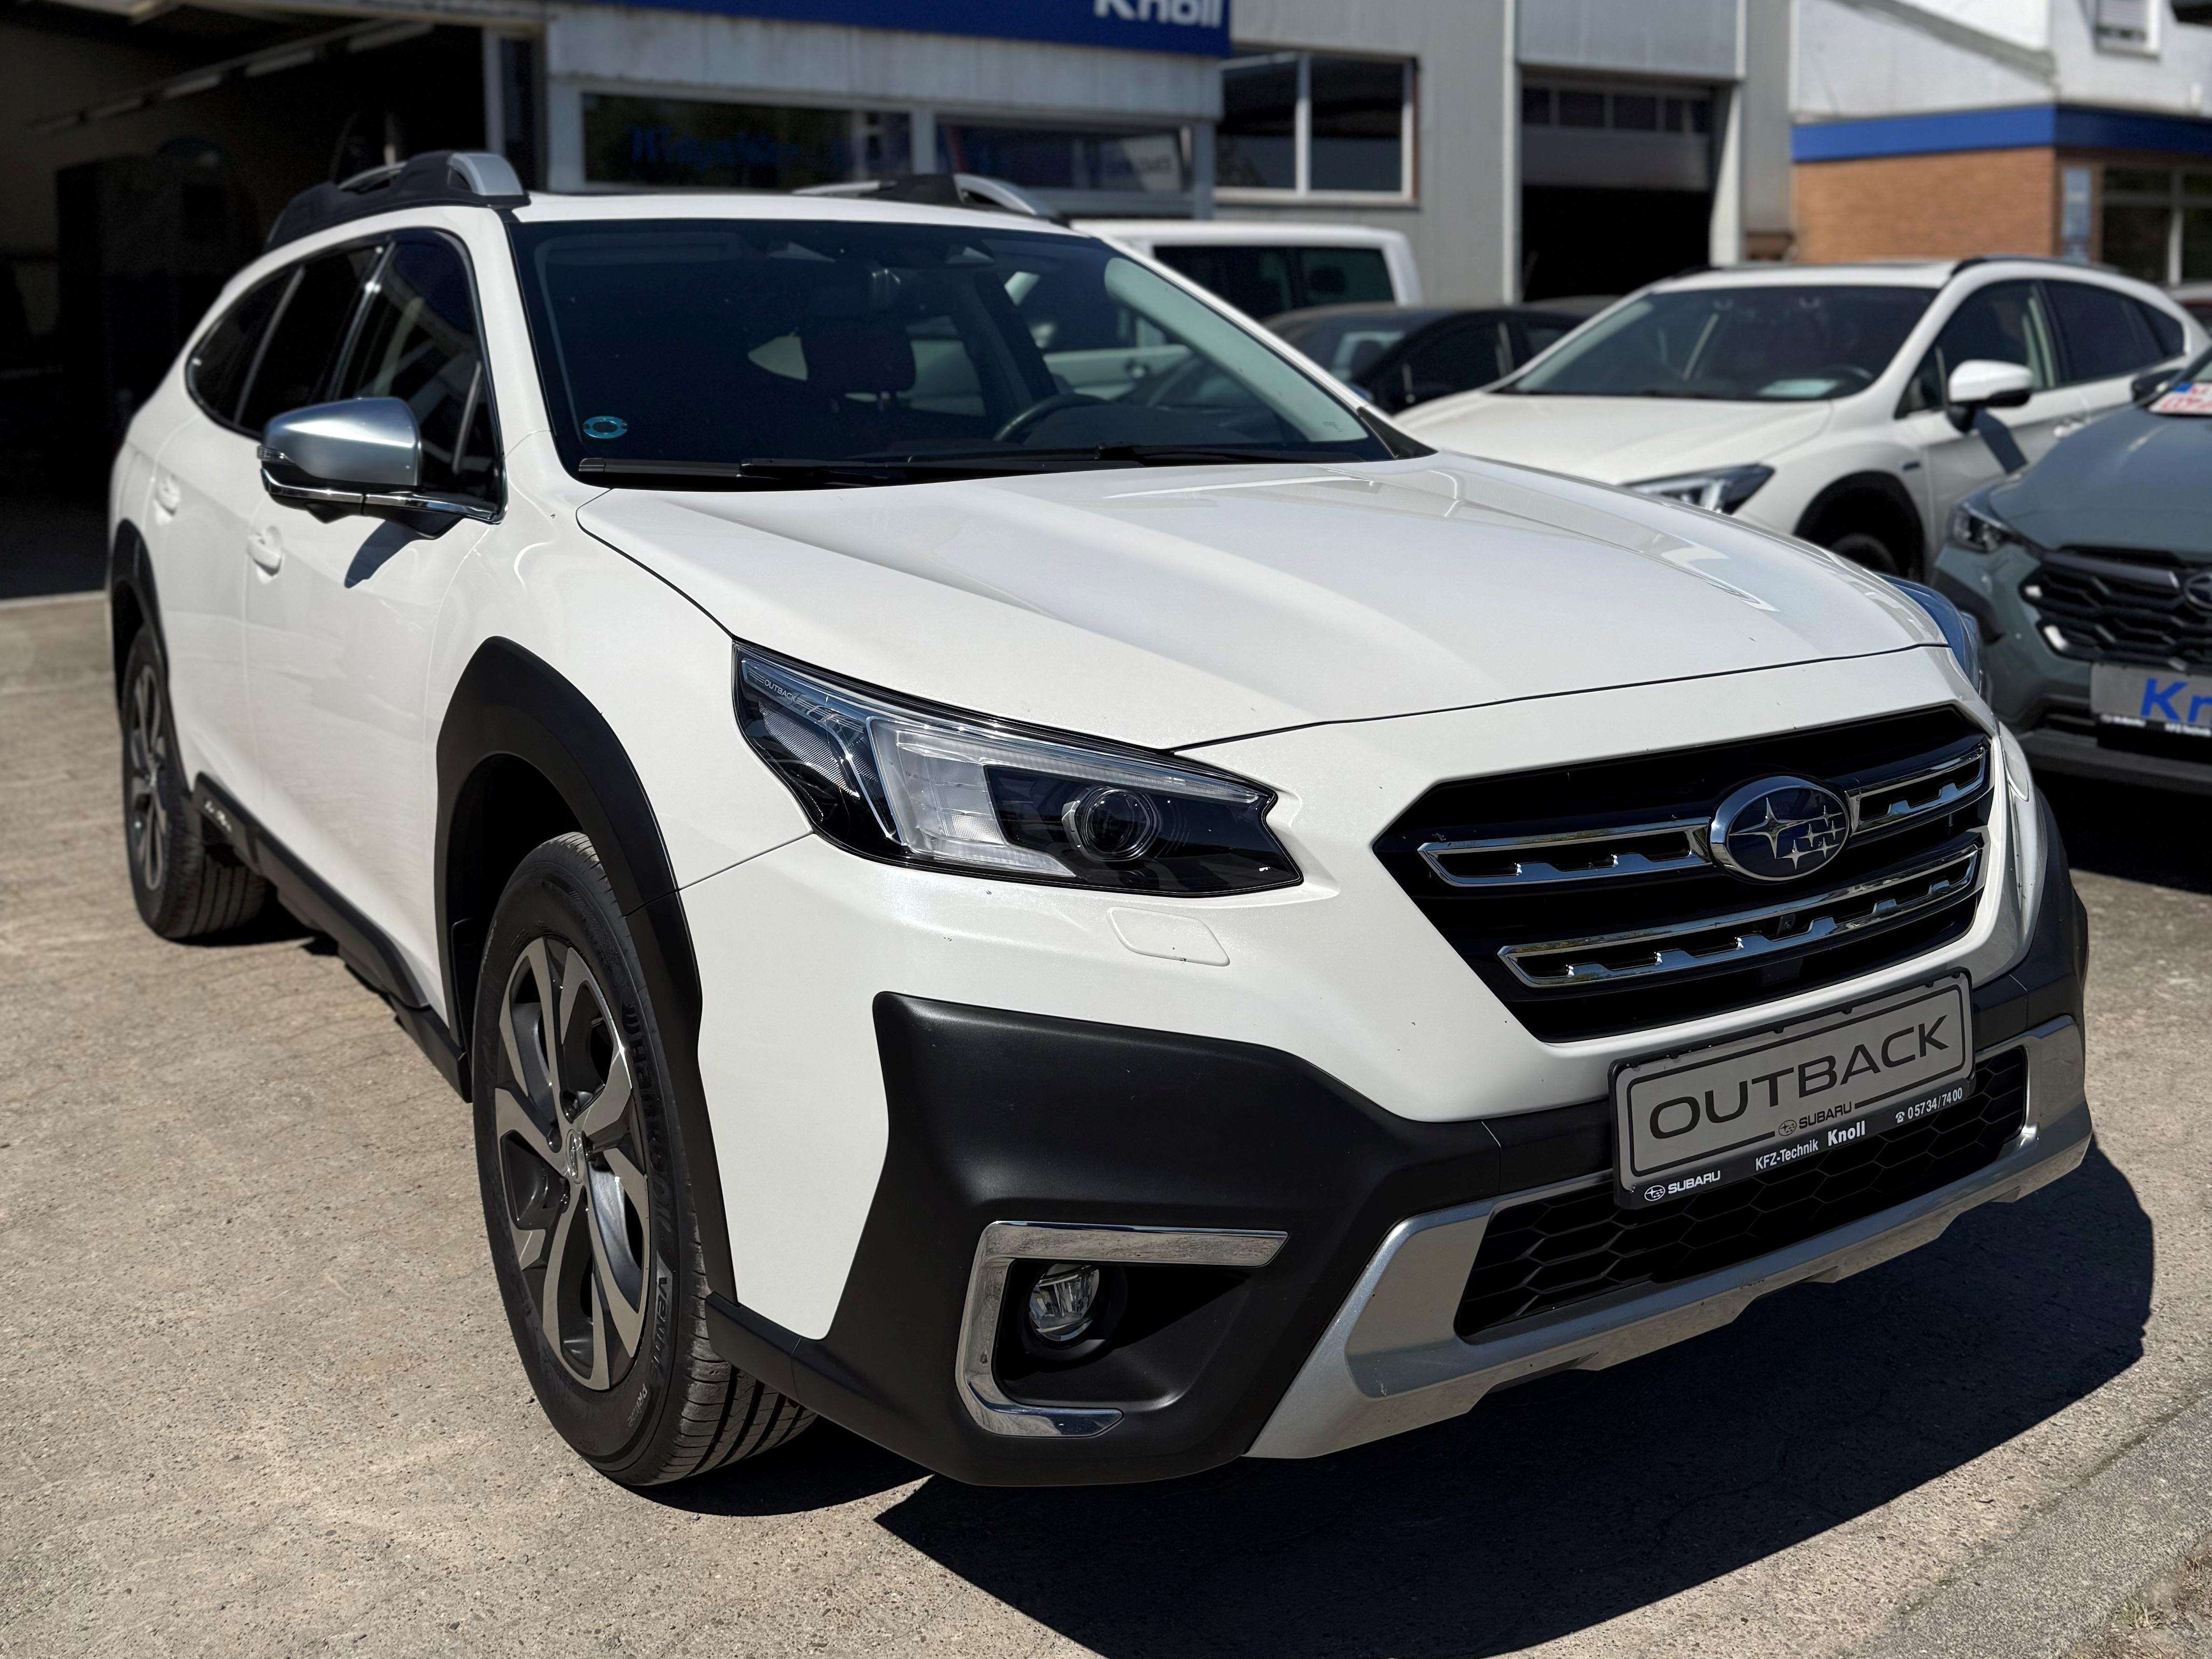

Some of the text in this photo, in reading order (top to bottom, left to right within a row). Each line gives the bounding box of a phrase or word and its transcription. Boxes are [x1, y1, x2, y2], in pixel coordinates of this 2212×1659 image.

[764, 679, 797, 703] OUTBACK
[1649, 1015, 1949, 1139] OUTBACK
[1799, 1102, 1852, 1129] SUBARU
[1668, 1170, 1721, 1194] SUBARU
[1755, 1139, 1819, 1171] KFZ-Technik
[1827, 1120, 1866, 1147] Knoll
